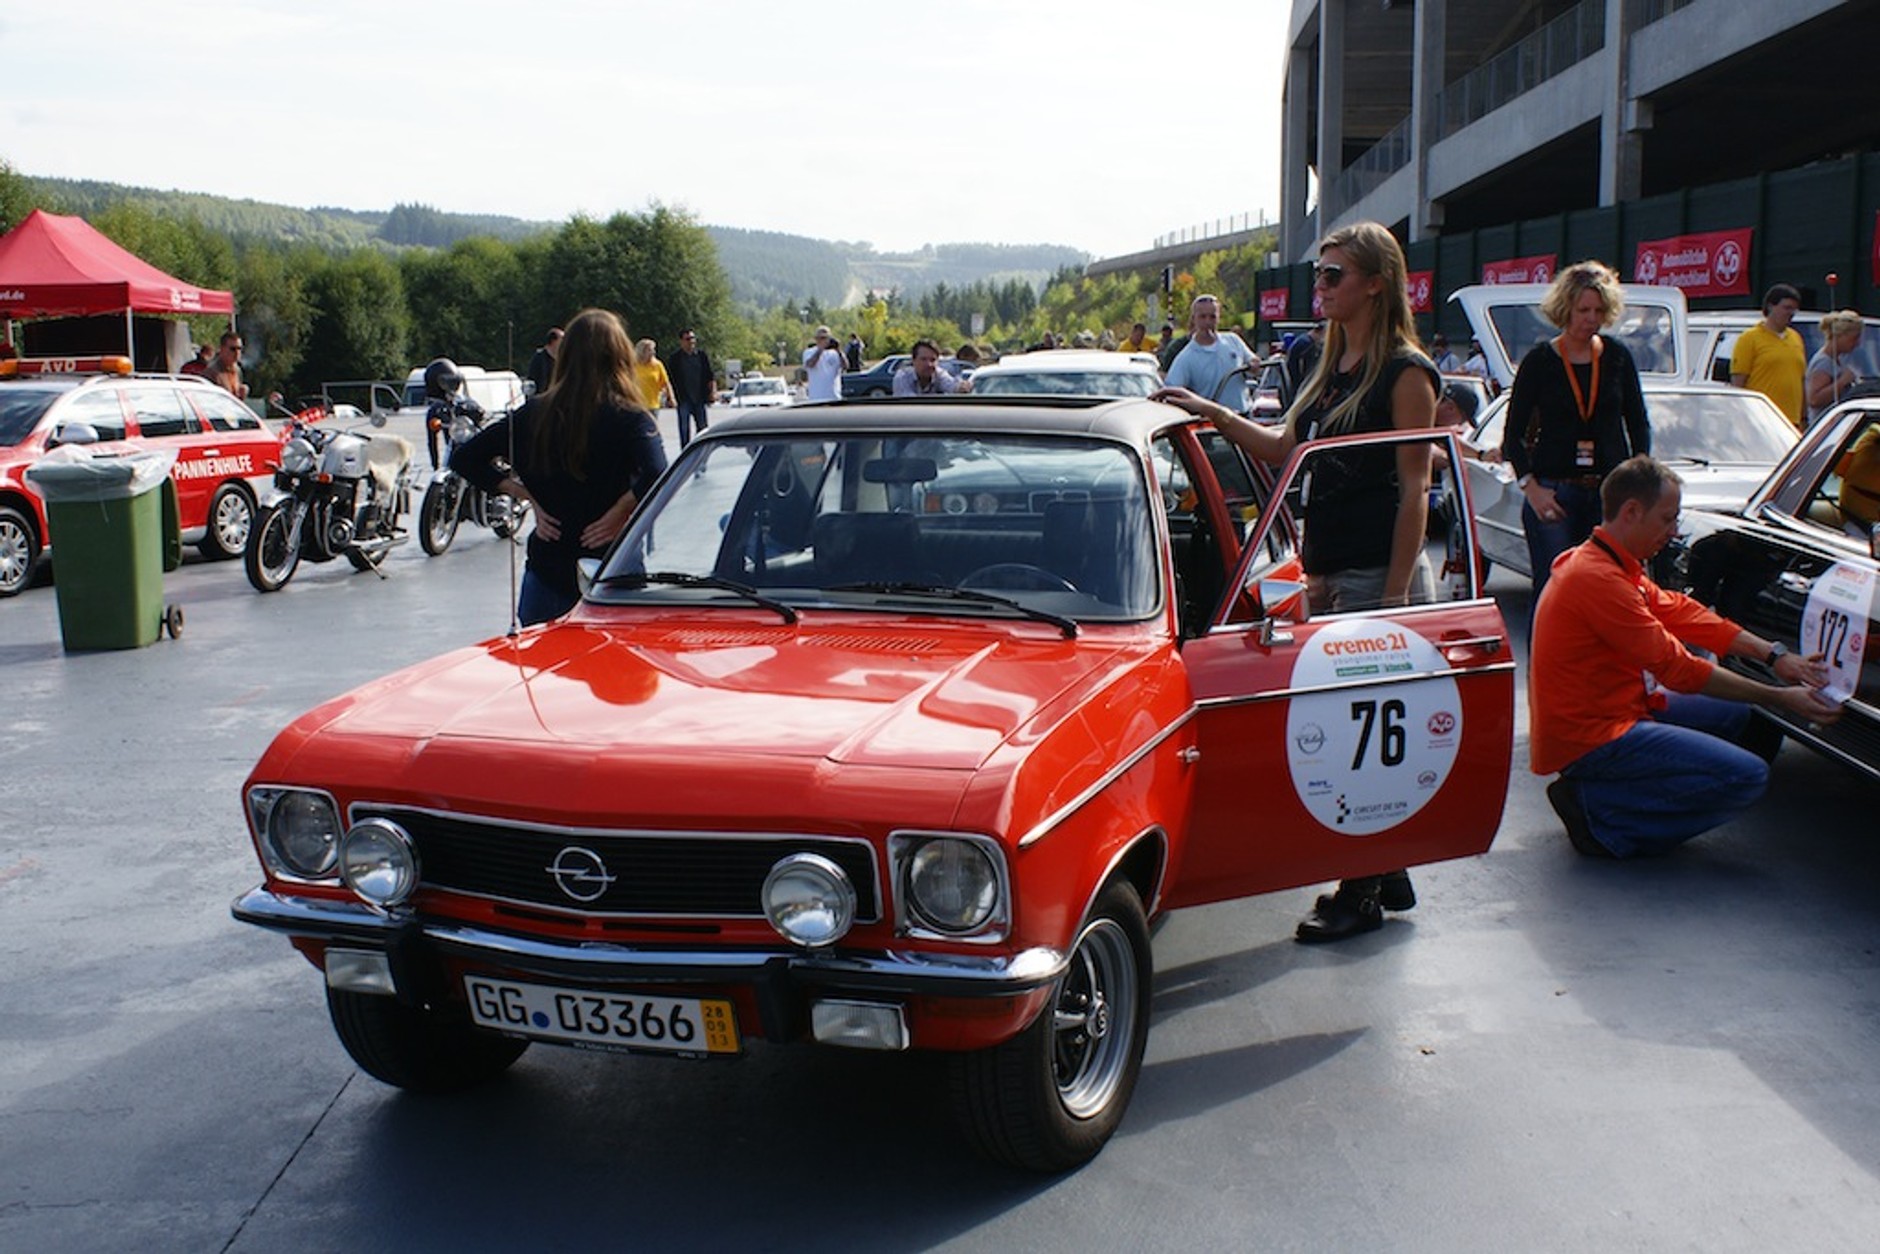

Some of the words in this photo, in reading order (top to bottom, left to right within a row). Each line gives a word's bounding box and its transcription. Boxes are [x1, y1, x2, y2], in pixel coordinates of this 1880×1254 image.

[174, 455, 253, 480] PANNENHILFE
[1323, 638, 1387, 655] creme
[1819, 608, 1848, 668] 172
[1350, 699, 1406, 770] 76
[472, 982, 530, 1026] GG
[555, 993, 695, 1043] 03366
[705, 1006, 724, 1018] 28
[707, 1020, 727, 1032] 09
[710, 1034, 729, 1046] 13
